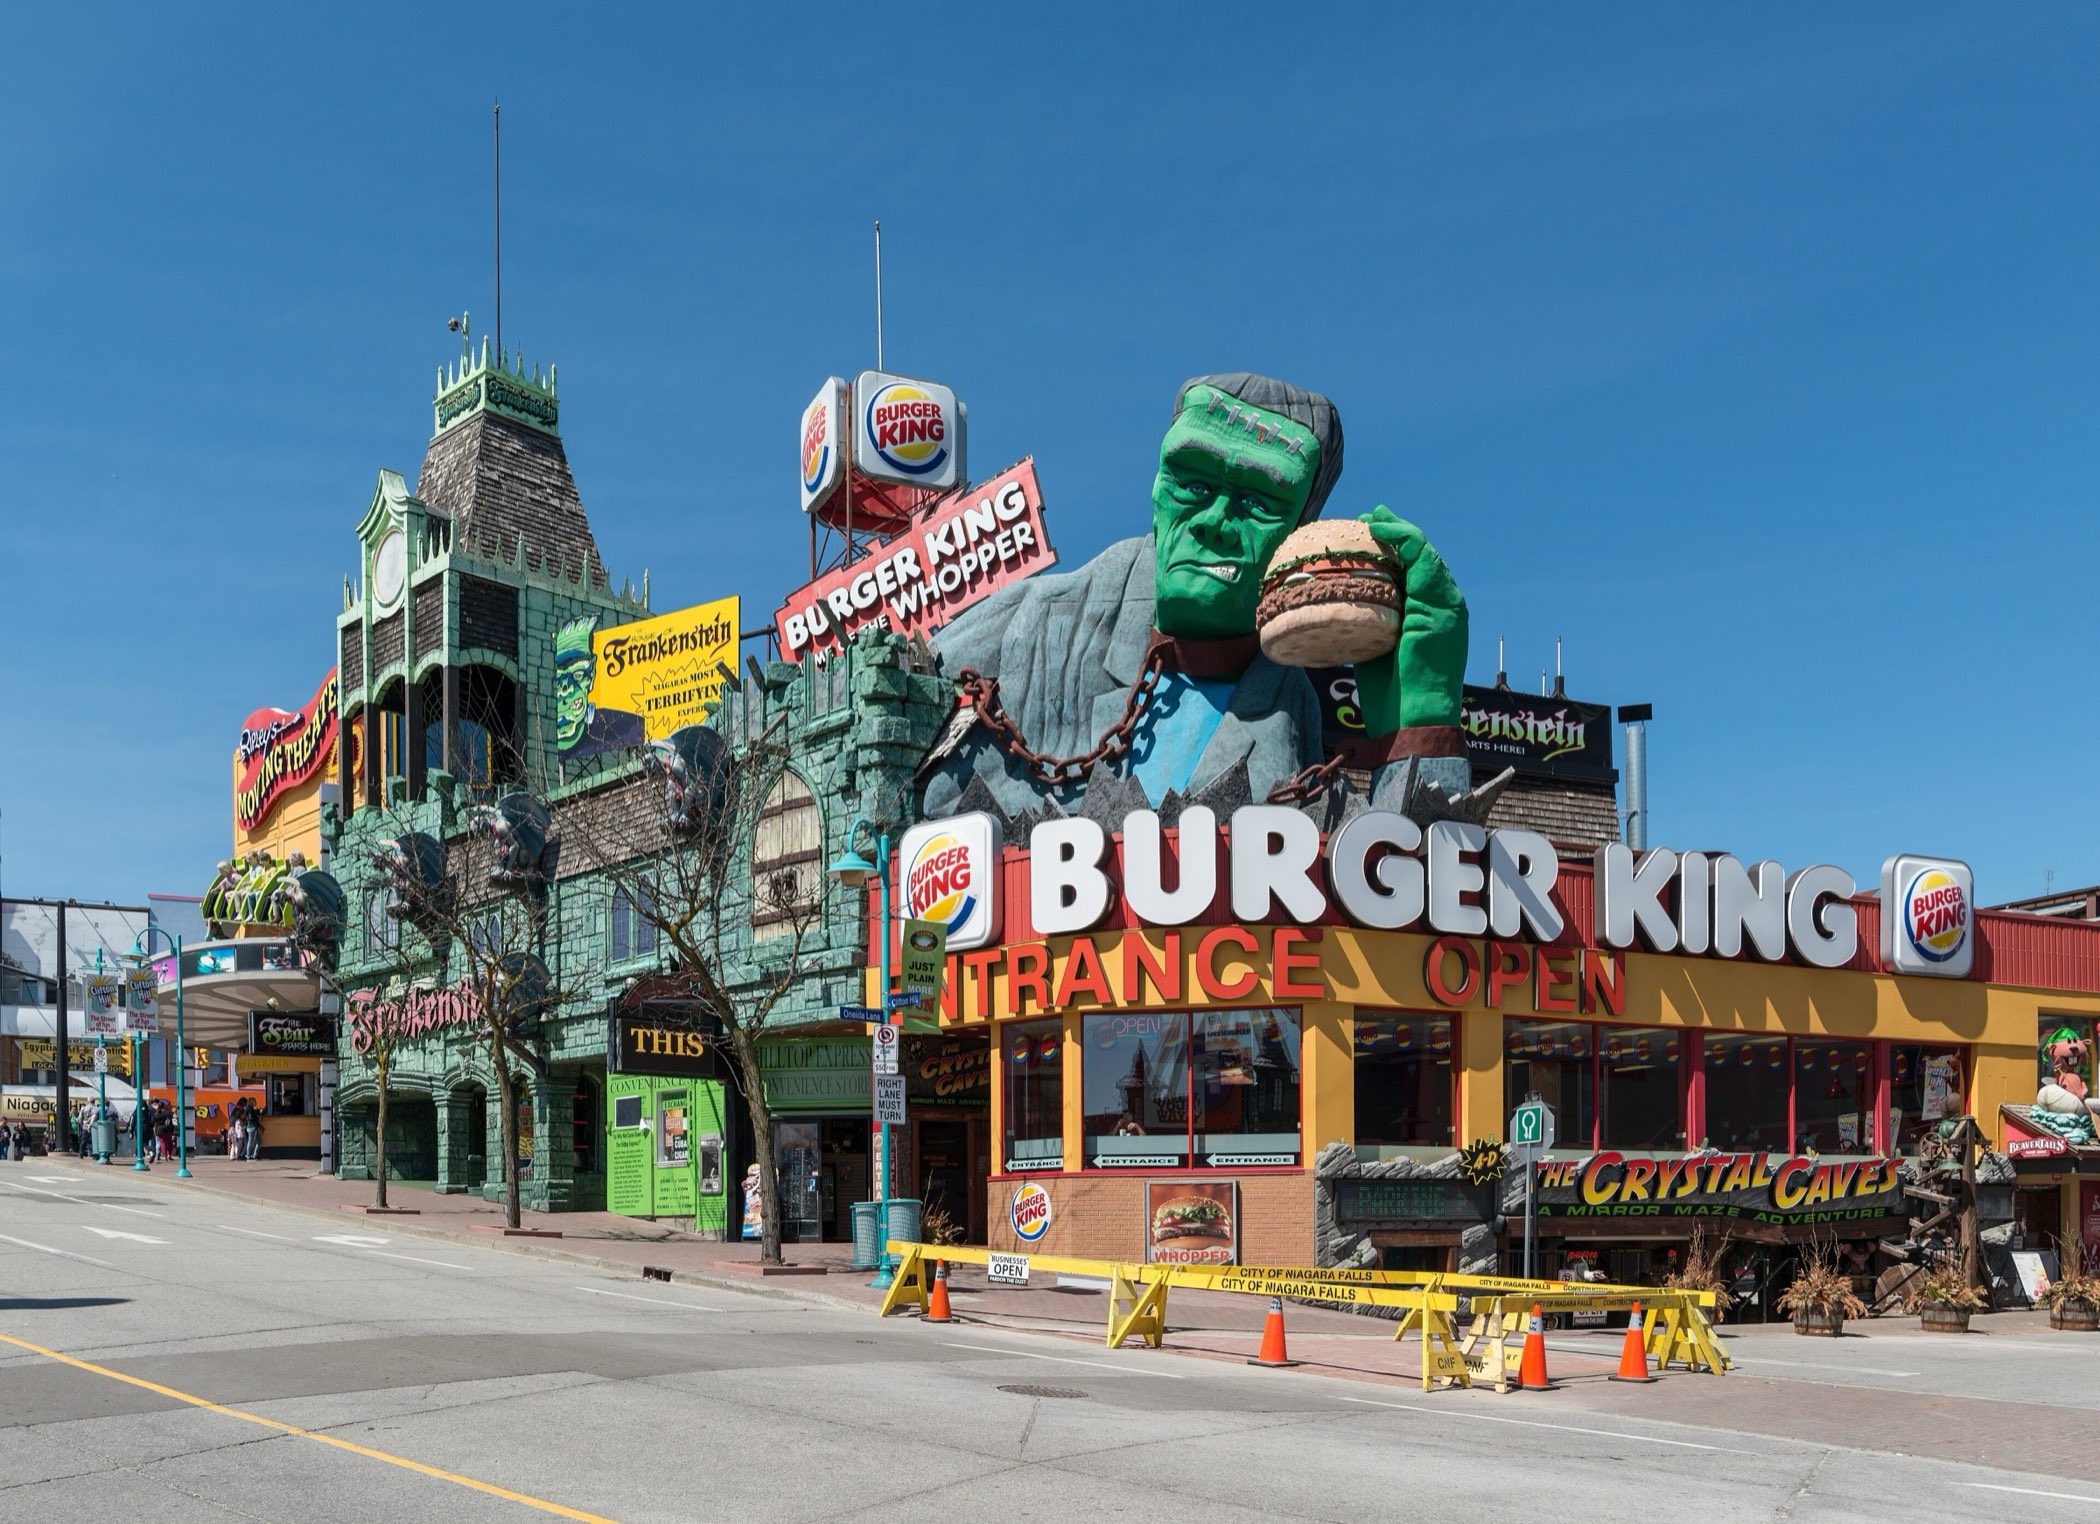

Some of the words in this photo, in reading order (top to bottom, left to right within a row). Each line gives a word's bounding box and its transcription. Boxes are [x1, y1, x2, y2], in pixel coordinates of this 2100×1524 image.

[875, 402, 941, 426] BURGER
[878, 420, 945, 450] KING
[784, 547, 921, 650] BURGER
[924, 481, 1026, 567] KING
[890, 521, 1035, 621] WHOPPER
[603, 612, 732, 678] Frankenstein
[652, 677, 689, 692] NIAGARAS
[690, 669, 716, 684] MOST
[677, 705, 706, 717] EXPERI
[238, 745, 282, 820] MOVING
[285, 676, 338, 772] THEATE
[1466, 740, 1491, 751] ARTS
[1493, 743, 1525, 755] HERE!
[910, 845, 970, 893] BURGER
[912, 863, 971, 919] KING
[1030, 804, 1564, 943] BURGER
[1596, 841, 1858, 969] KING
[1913, 886, 1965, 918] BURGER
[1914, 902, 1967, 943] KING
[908, 961, 936, 972] JUST
[907, 973, 935, 984] PLAIN
[1422, 936, 1626, 1016] OPEN
[90, 985, 116, 995] Clifton
[129, 980, 156, 990] Clifton
[907, 985, 934, 995] MORE
[98, 994, 112, 1004] Hill
[137, 989, 151, 999] Hill
[891, 997, 909, 1008] Clifton
[909, 995, 919, 1004] Hill
[843, 1009, 865, 1020] Oneida
[866, 1010, 881, 1021] Lane
[288, 1019, 302, 1028] THE
[1111, 1017, 1161, 1034] OPEN
[259, 1017, 316, 1045] Fear
[24, 1041, 57, 1053] Egyptia
[309, 1041, 331, 1052] HERE
[630, 1028, 704, 1058] THIS
[942, 1042, 960, 1056] THE
[756, 1044, 813, 1069] HILLTOP
[816, 1044, 873, 1068] EXPRESS
[920, 1048, 990, 1079] CRYST
[876, 1064, 886, 1072] $50
[766, 1076, 834, 1096] ONVENIENCE
[877, 1079, 902, 1089] RIGHT
[935, 1068, 990, 1097] CAVE
[878, 1090, 901, 1100] LANE
[7, 1098, 56, 1114] Niagar
[664, 1100, 687, 1109] EXCHANG
[878, 1101, 901, 1110] MUST
[879, 1111, 901, 1121] TURN
[674, 1139, 687, 1149] CUBA
[674, 1151, 687, 1160] CIGAR
[1102, 1157, 1176, 1165] ENTRANCE
[1214, 1156, 1292, 1164] ENTRANCE
[1011, 1160, 1062, 1169] ENTRANCE
[1537, 1161, 1580, 1188] THE
[1582, 1151, 1772, 1206] CRYSTAL
[1774, 1157, 1906, 1210] CAVES
[1015, 1193, 1046, 1215] BURGER
[1016, 1203, 1047, 1229] KING
[1538, 1206, 1552, 1216] A
[1567, 1206, 1661, 1216] MIRROR
[1675, 1204, 1740, 1217] MAZE
[1753, 1207, 1887, 1225] ADVENTURE
[1154, 1250, 1230, 1263] WHOPPER
[993, 1264, 1023, 1278] OPEN
[1239, 1267, 1266, 1278] CITY
[1268, 1269, 1283, 1278] OF
[1285, 1270, 1335, 1280] NIAGARA
[1338, 1271, 1372, 1281] FALLS
[1221, 1278, 1246, 1289] CITY
[1247, 1280, 1262, 1291] OF
[1265, 1283, 1317, 1297] NIAGARA
[1318, 1287, 1356, 1300] FALLS
[1503, 1280, 1530, 1289] NIAGARA
[1531, 1282, 1551, 1291] FALLS
[1437, 1357, 1456, 1370] CNF
[1464, 1359, 1489, 1374] CNF
